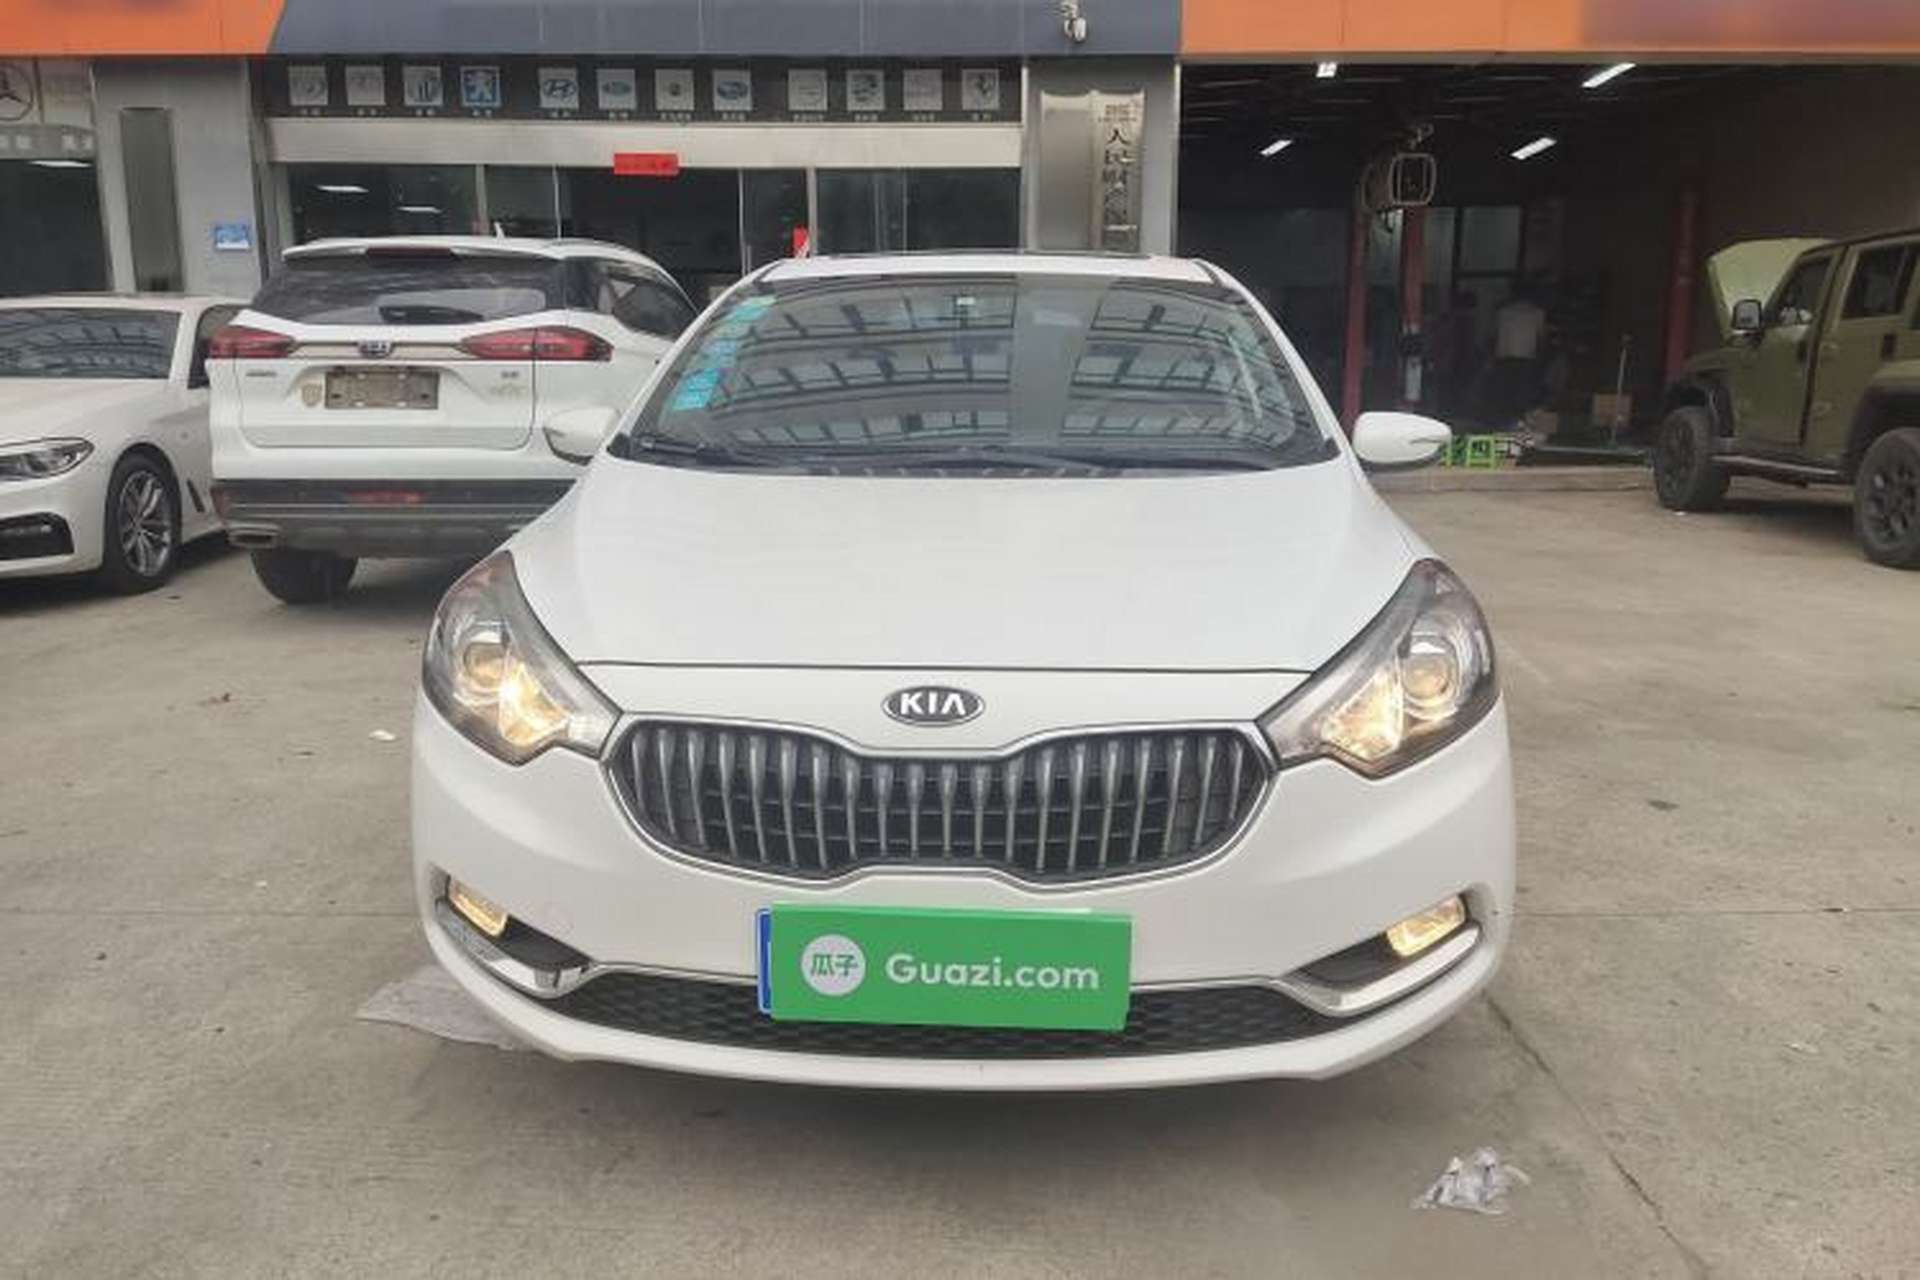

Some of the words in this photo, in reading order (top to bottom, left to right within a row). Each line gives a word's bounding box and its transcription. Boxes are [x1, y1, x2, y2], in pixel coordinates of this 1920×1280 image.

[900, 692, 967, 715] KIA
[810, 953, 859, 978] 瓜子
[885, 953, 1100, 989] Guazi.com
